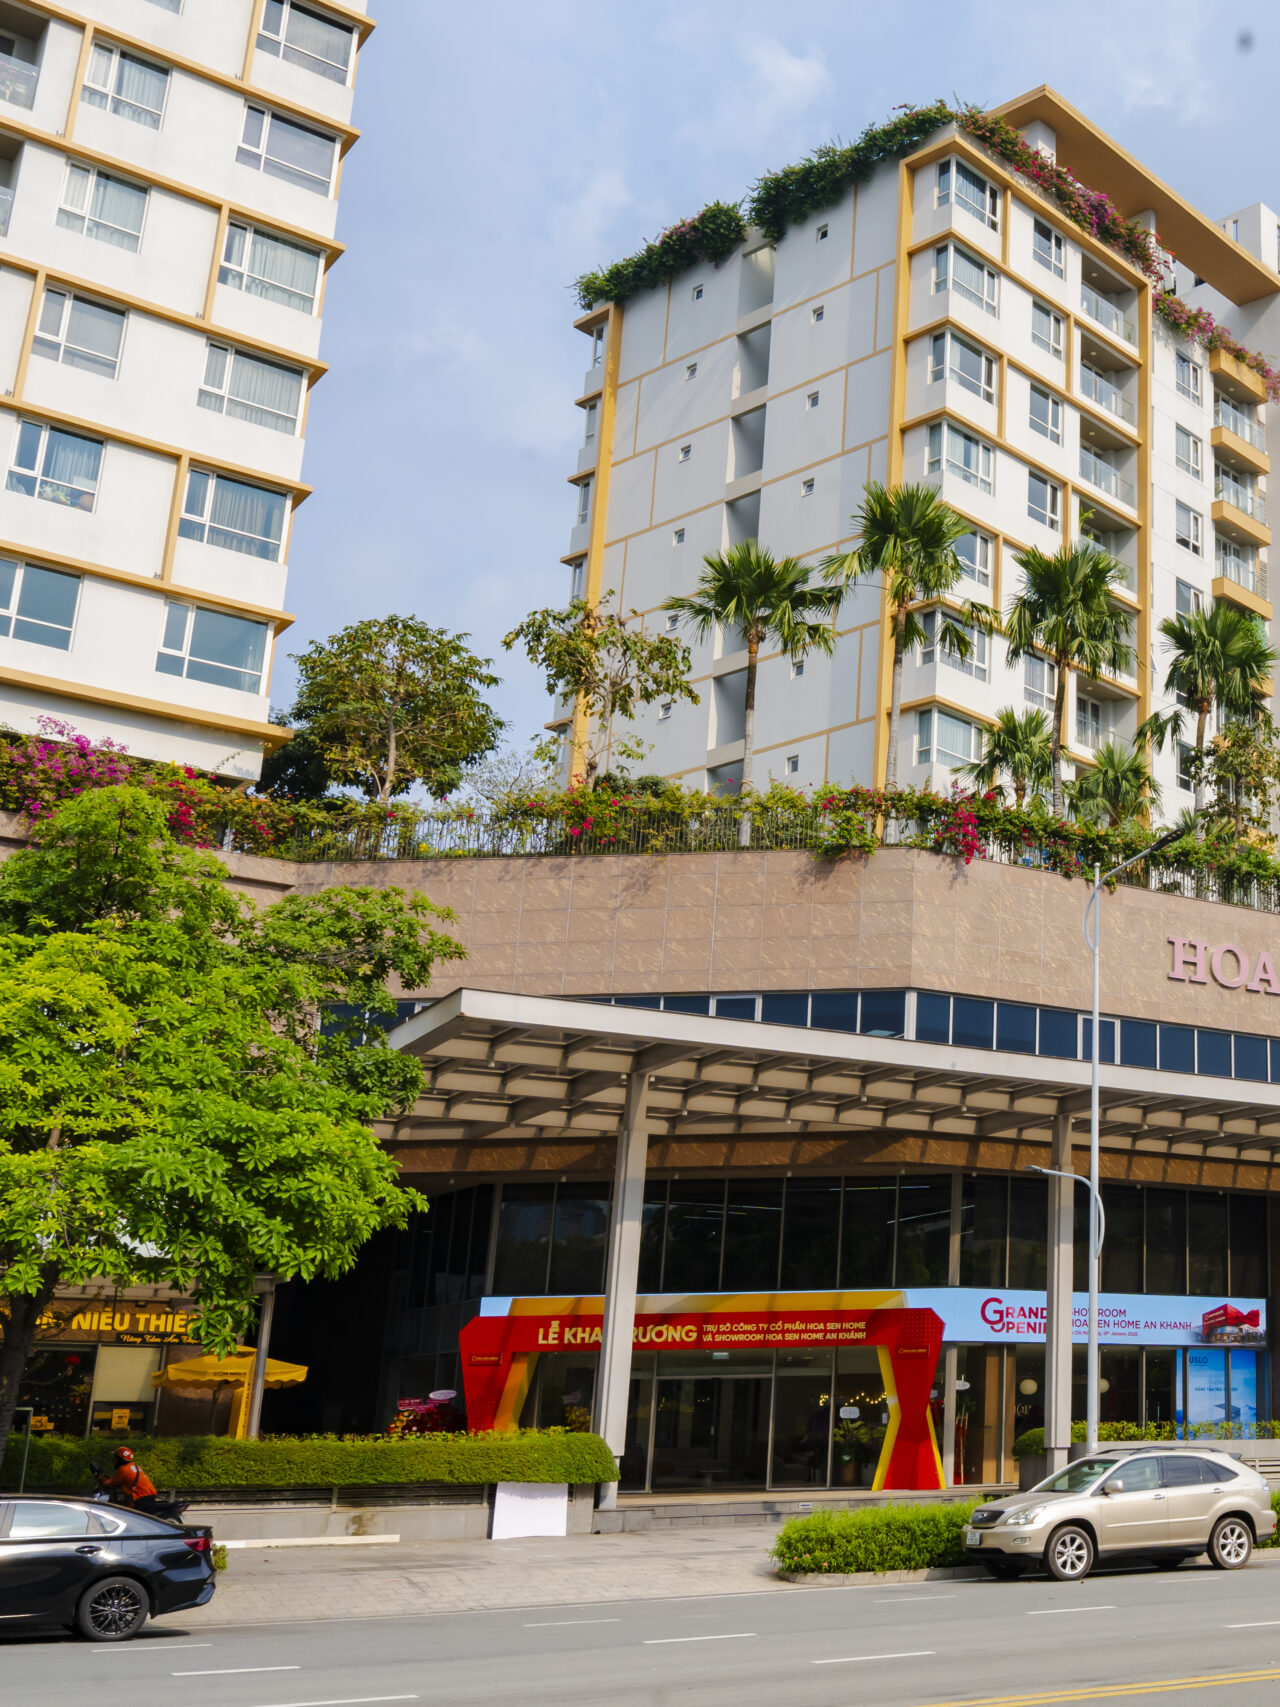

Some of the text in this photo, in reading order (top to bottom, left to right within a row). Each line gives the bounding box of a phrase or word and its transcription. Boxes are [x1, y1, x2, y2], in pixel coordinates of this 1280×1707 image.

[981, 1297, 1047, 1325] GRAND
[1072, 1308, 1126, 1318] HOROOM
[135, 1310, 199, 1332] THIÊ
[702, 1324, 718, 1333] TRỤ
[732, 1321, 757, 1331] CÔNG
[758, 1323, 769, 1331] TY
[807, 1322, 825, 1330] HOA
[826, 1322, 841, 1330] SEN
[843, 1321, 866, 1329] HOME
[1097, 1320, 1110, 1328] EN
[1113, 1320, 1141, 1329] HOME
[1143, 1320, 1157, 1330] AN
[1160, 1321, 1192, 1330] KHANH
[538, 1320, 698, 1344] LỄ KHA RƯƠNG
[702, 1330, 867, 1342] VÀ SHOWROOM HOA SEN HOME AN KHÁNH
